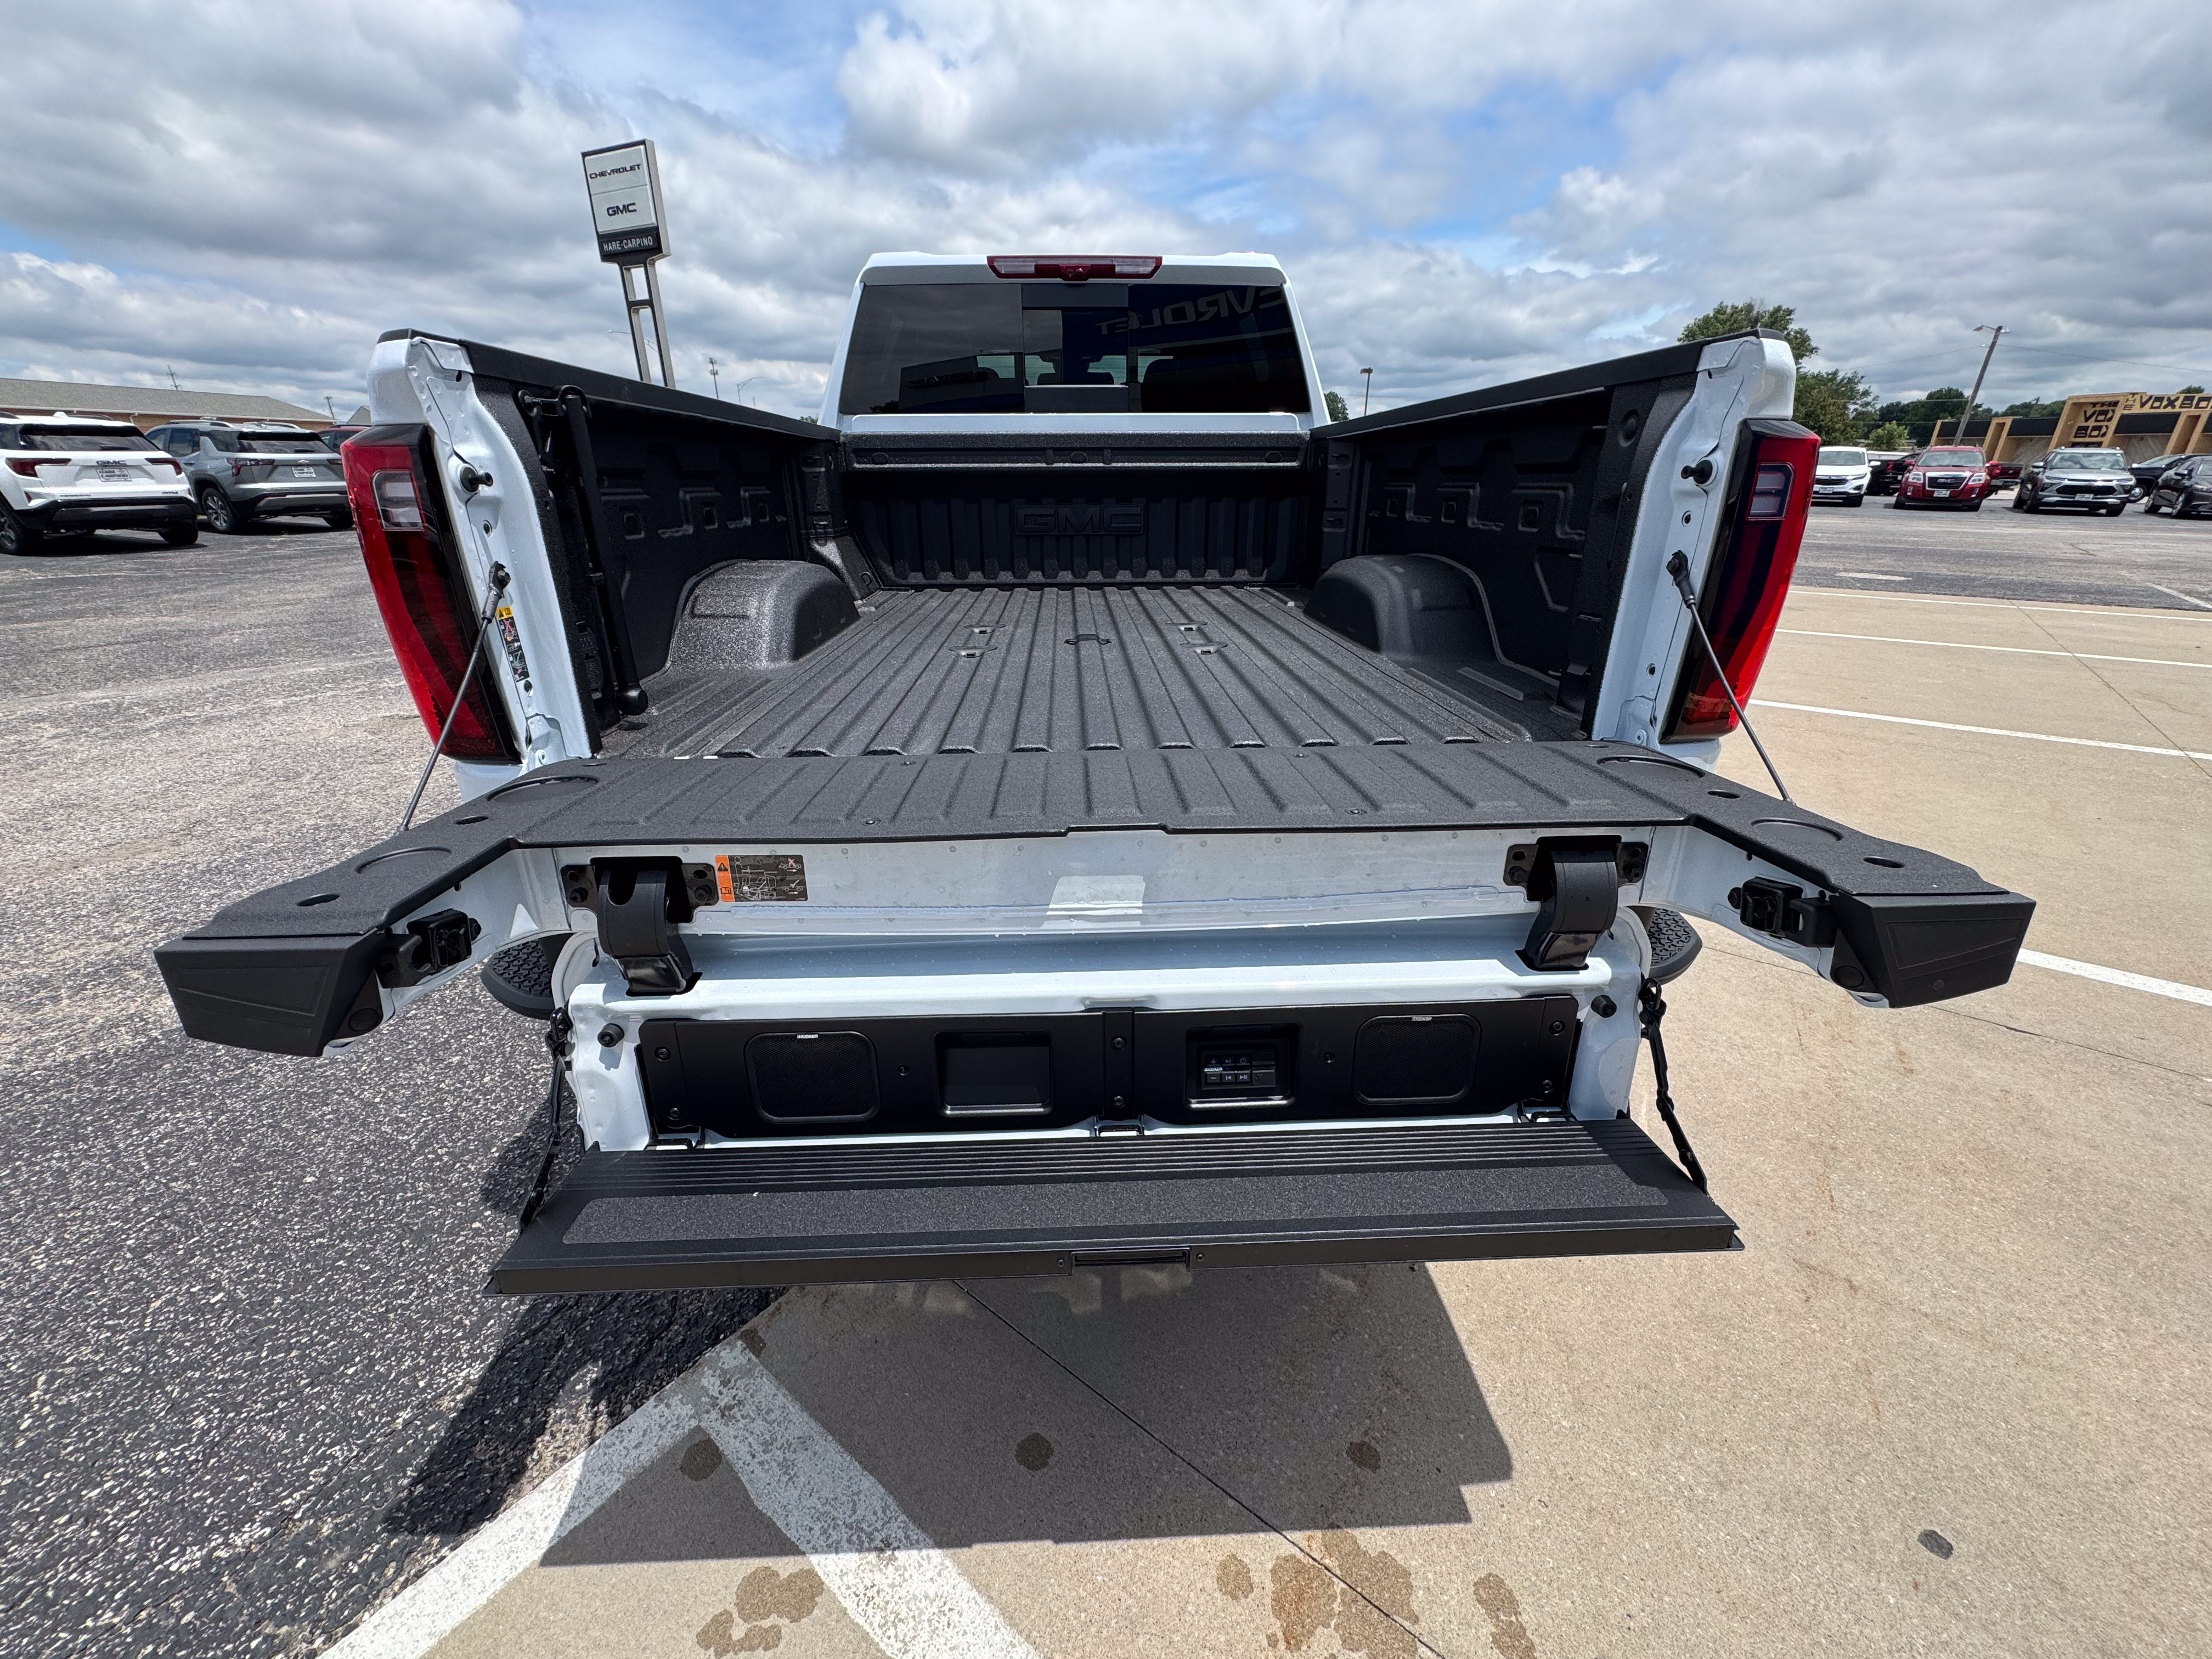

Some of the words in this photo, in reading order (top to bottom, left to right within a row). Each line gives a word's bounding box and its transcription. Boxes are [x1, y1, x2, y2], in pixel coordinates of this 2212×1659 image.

[589, 163, 641, 179] CHEVROLET
[607, 202, 637, 216] GMC
[603, 236, 653, 251] HARE-CARPINO
[2140, 395, 2212, 409] VOXBO
[1017, 506, 1142, 533] GMC
